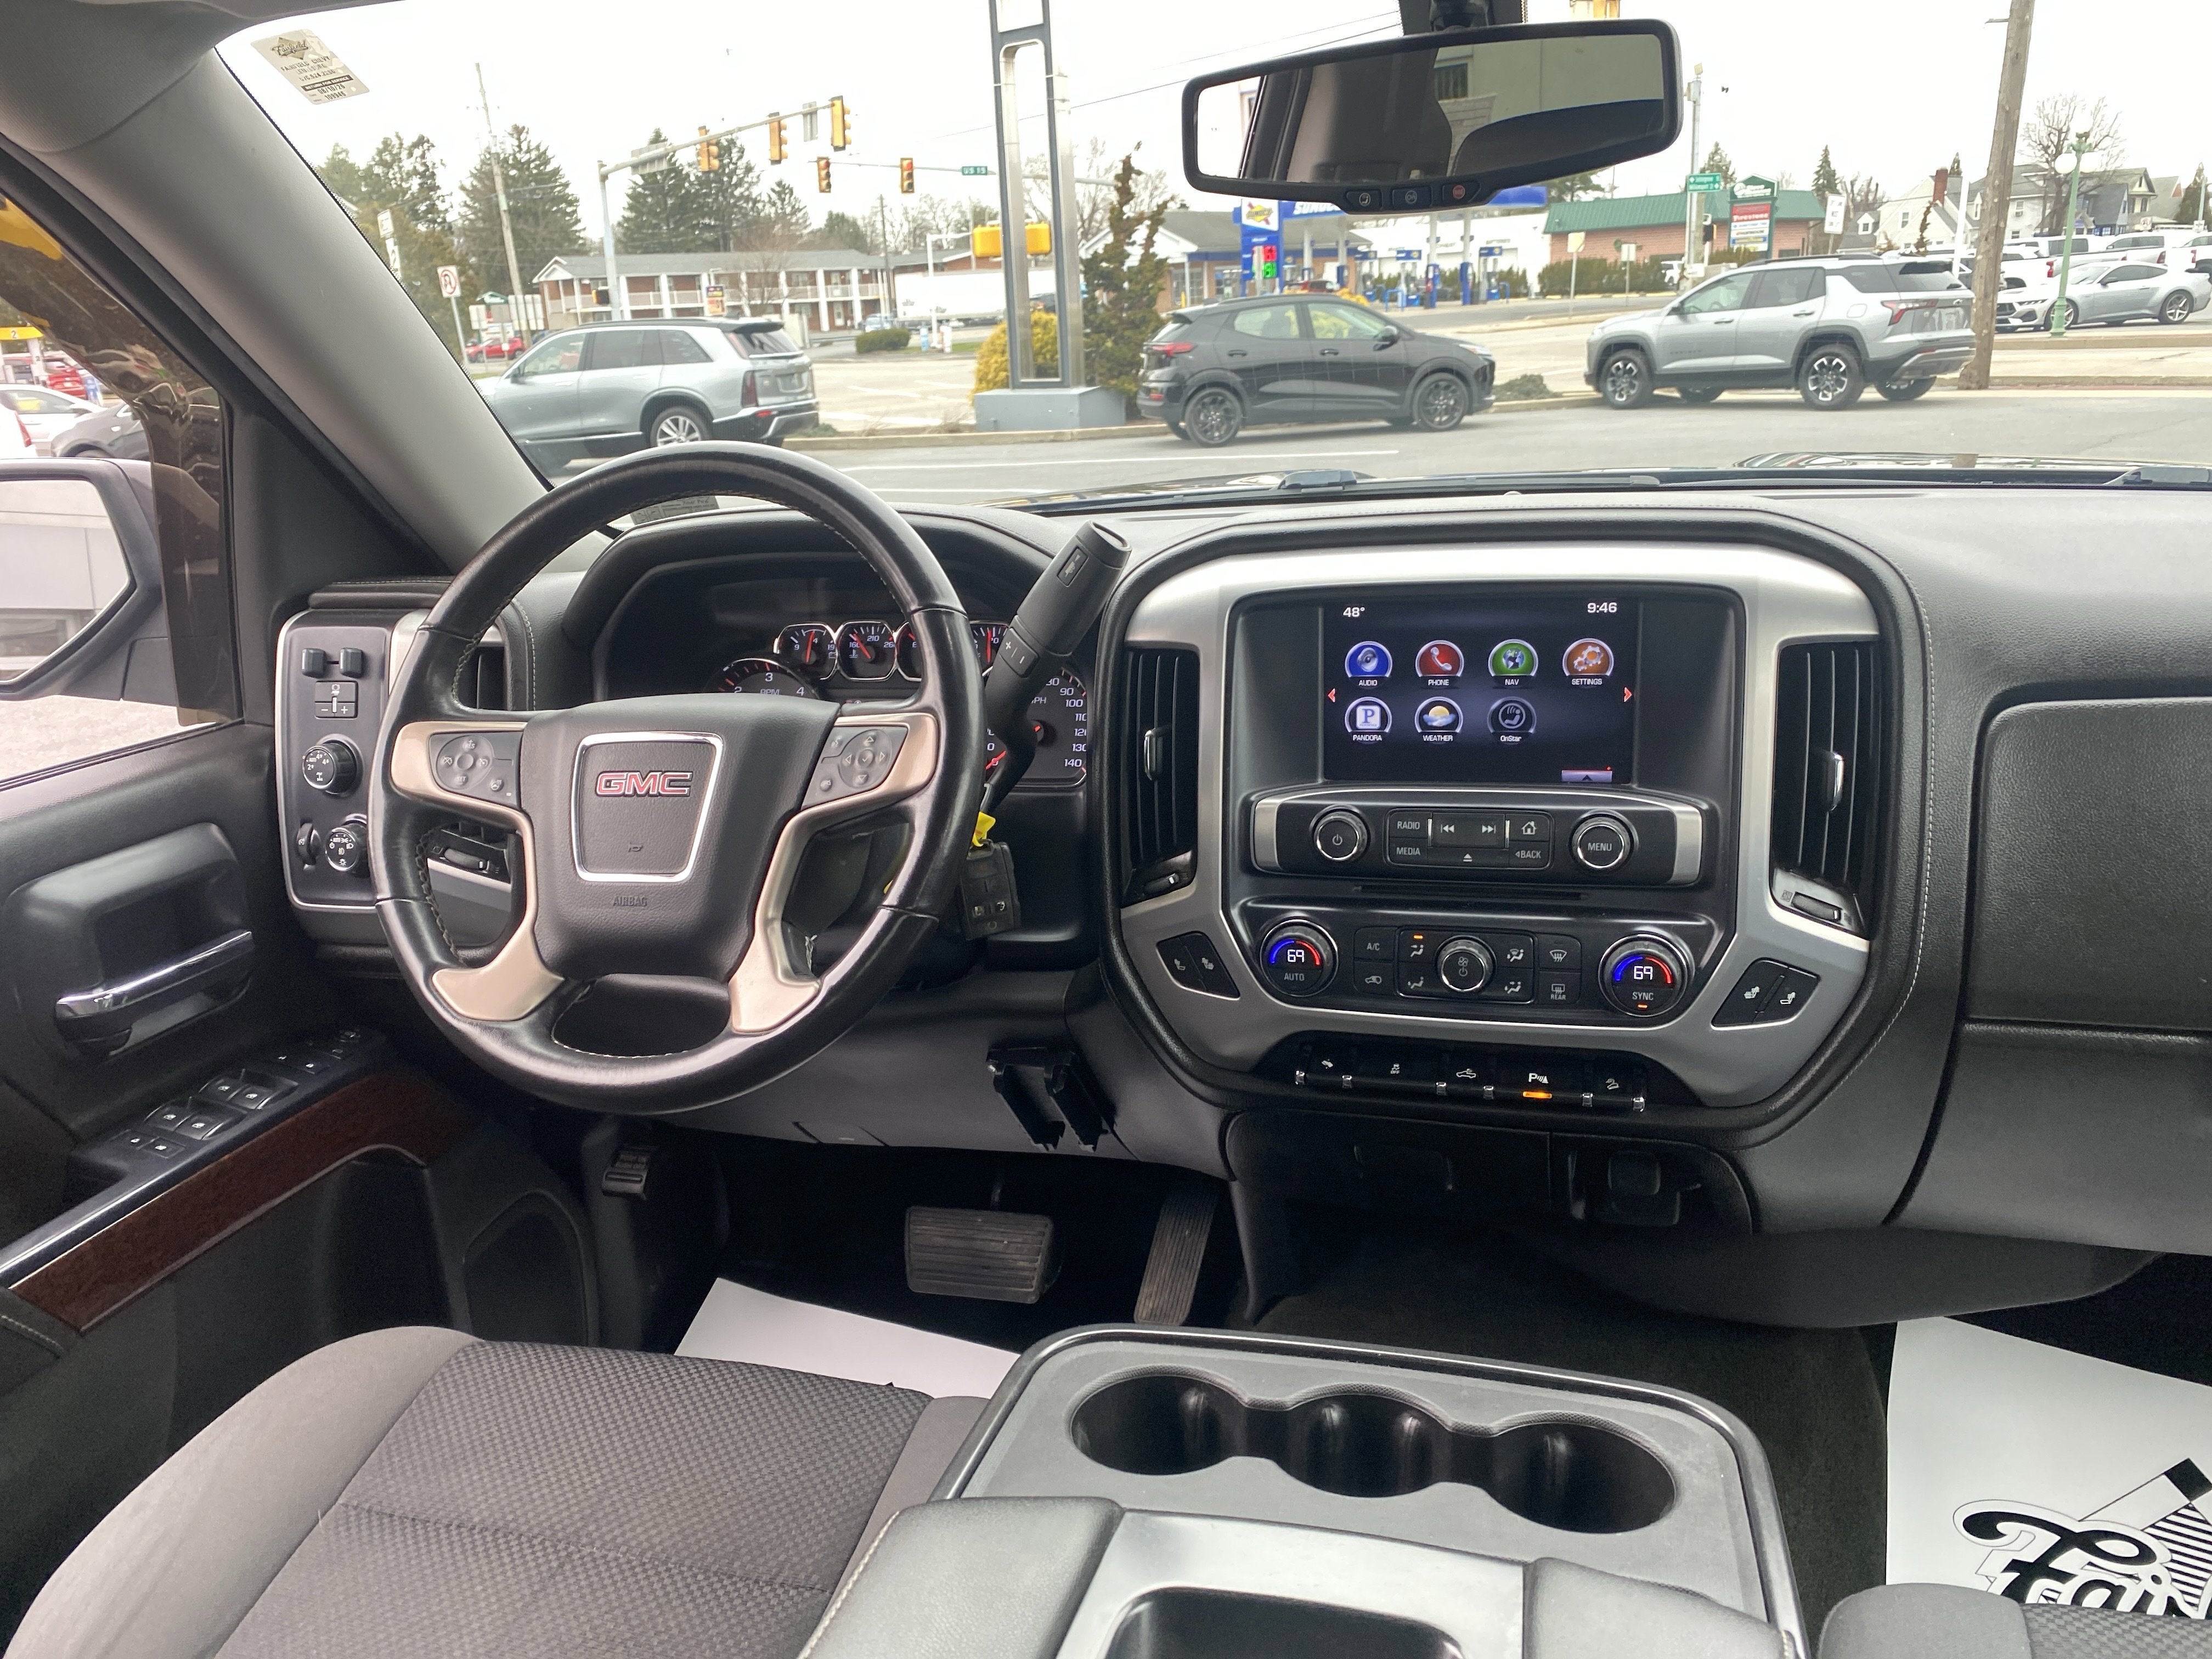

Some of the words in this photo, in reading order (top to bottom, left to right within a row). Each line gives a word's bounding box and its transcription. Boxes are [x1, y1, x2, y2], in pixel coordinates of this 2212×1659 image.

[272, 41, 308, 55] Fairfield
[318, 84, 346, 94] 08/10/26
[1587, 602, 1617, 613] 9:46
[765, 672, 773, 682] 3
[797, 687, 804, 696] 4
[1059, 687, 1074, 696] 90
[1065, 699, 1084, 708] 100
[1064, 759, 1082, 767] 140
[596, 770, 693, 797] GMC
[1397, 821, 1420, 831] RADIO
[1396, 847, 1420, 856] MEDIA
[1588, 842, 1612, 851] MENU
[1520, 850, 1542, 859] BACK
[613, 896, 648, 907] AIRBAG
[1366, 942, 1380, 952] A/C
[1287, 949, 1305, 963] 69
[1284, 973, 1305, 982] AUTO
[1633, 966, 1654, 980] 69
[1632, 992, 1654, 1001] SYNC
